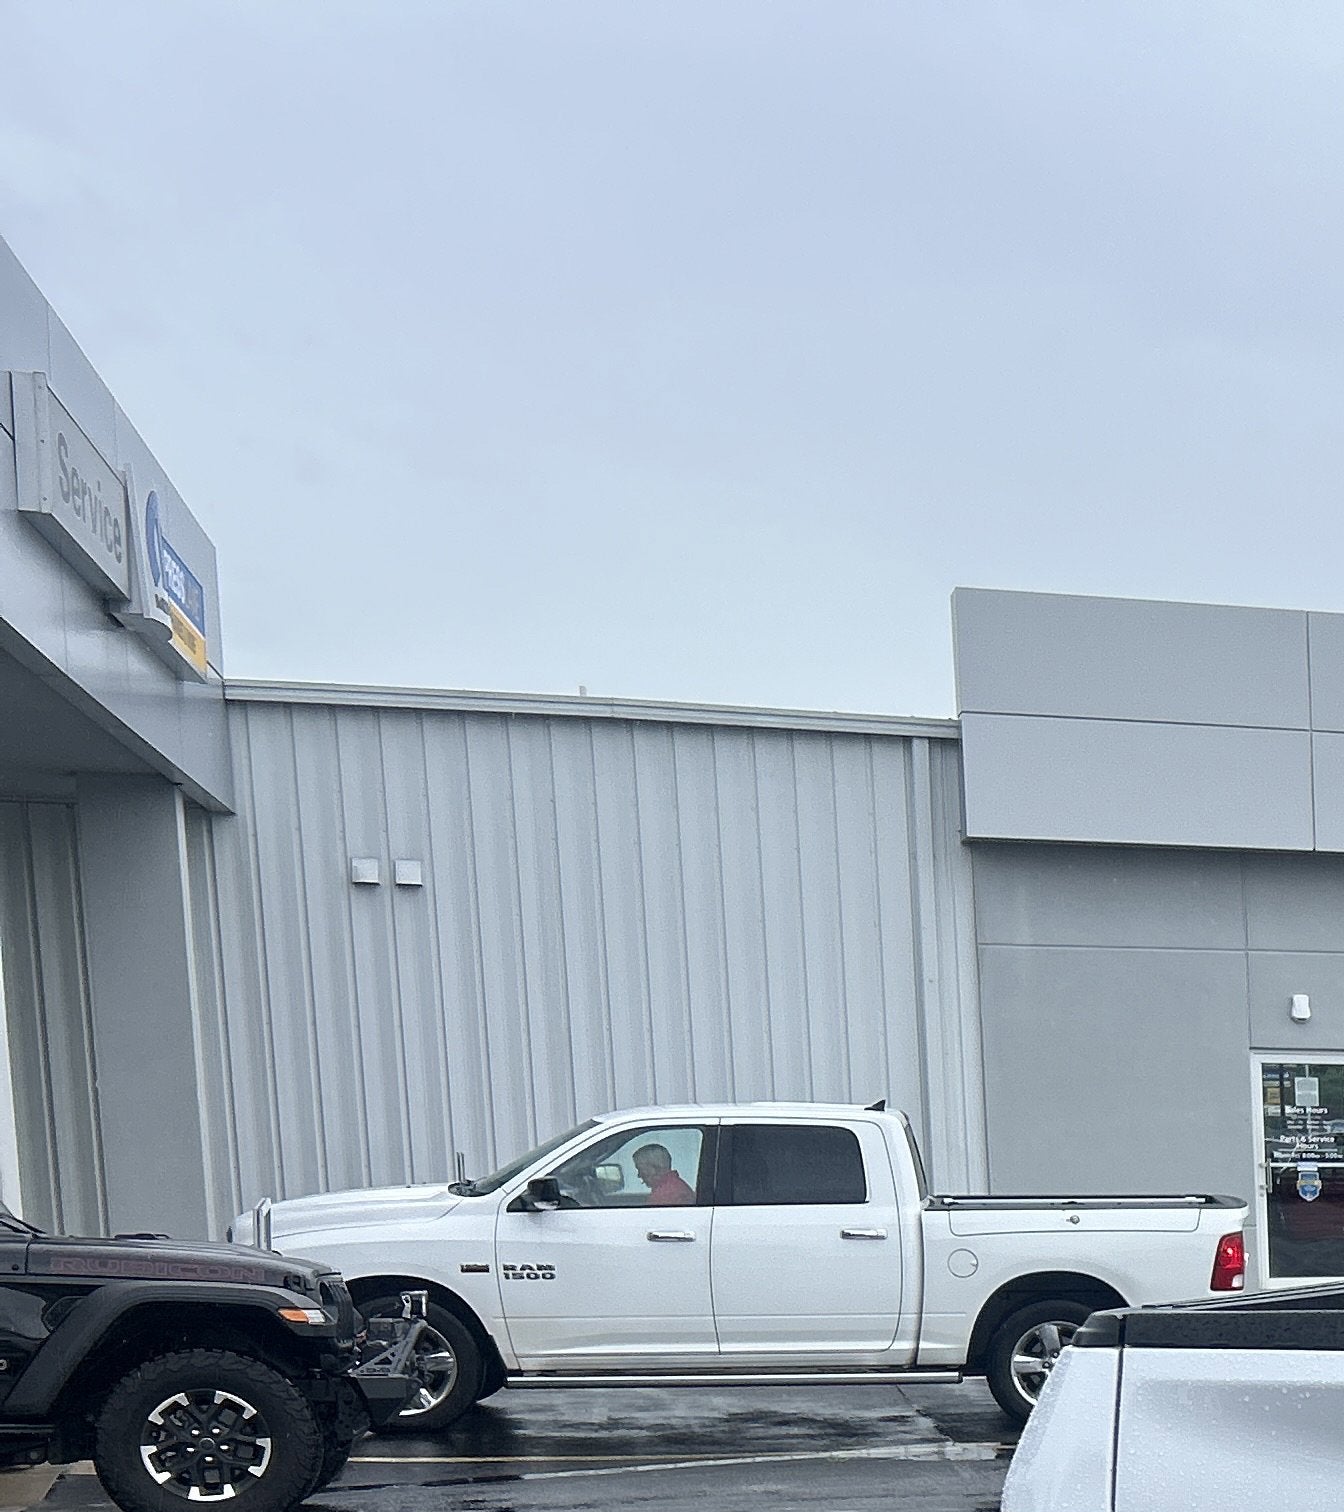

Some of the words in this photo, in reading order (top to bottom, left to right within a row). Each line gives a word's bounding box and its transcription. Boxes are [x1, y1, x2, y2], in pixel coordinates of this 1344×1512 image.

[57, 432, 122, 564] Service
[51, 1256, 265, 1283] RUBICON
[502, 1263, 556, 1271] RAM
[503, 1272, 556, 1280] 1500
